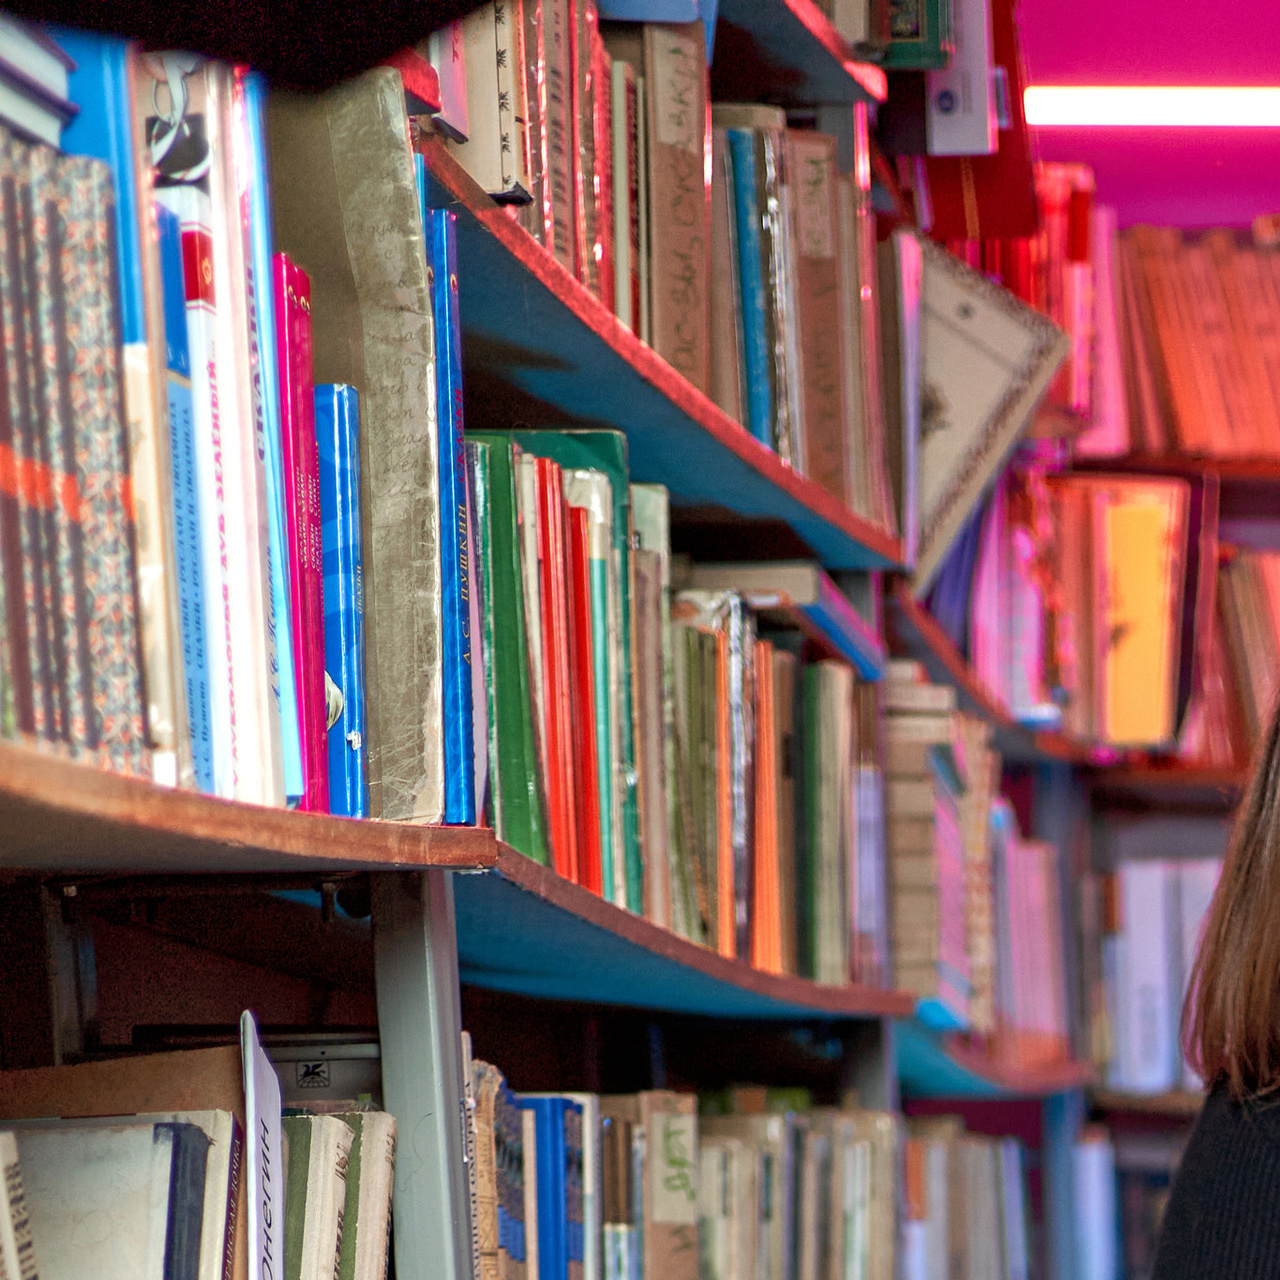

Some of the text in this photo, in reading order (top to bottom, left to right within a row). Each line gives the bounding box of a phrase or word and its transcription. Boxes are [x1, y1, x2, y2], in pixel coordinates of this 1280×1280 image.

[182, 407, 195, 499] ЛЮДМИЛА
[454, 386, 466, 484] СКАЗКИ
[189, 521, 200, 588] РУСЛАН
[216, 513, 229, 572] ДУБ
[457, 502, 469, 602] ПУШКИН
[193, 601, 204, 670] СКАЗКИ
[266, 545, 277, 648] Пушкин
[198, 681, 209, 743] Пушкин
[221, 582, 240, 767] ЛУКОМОРЬЯ
[231, 1138, 242, 1195] ДОЧКА
